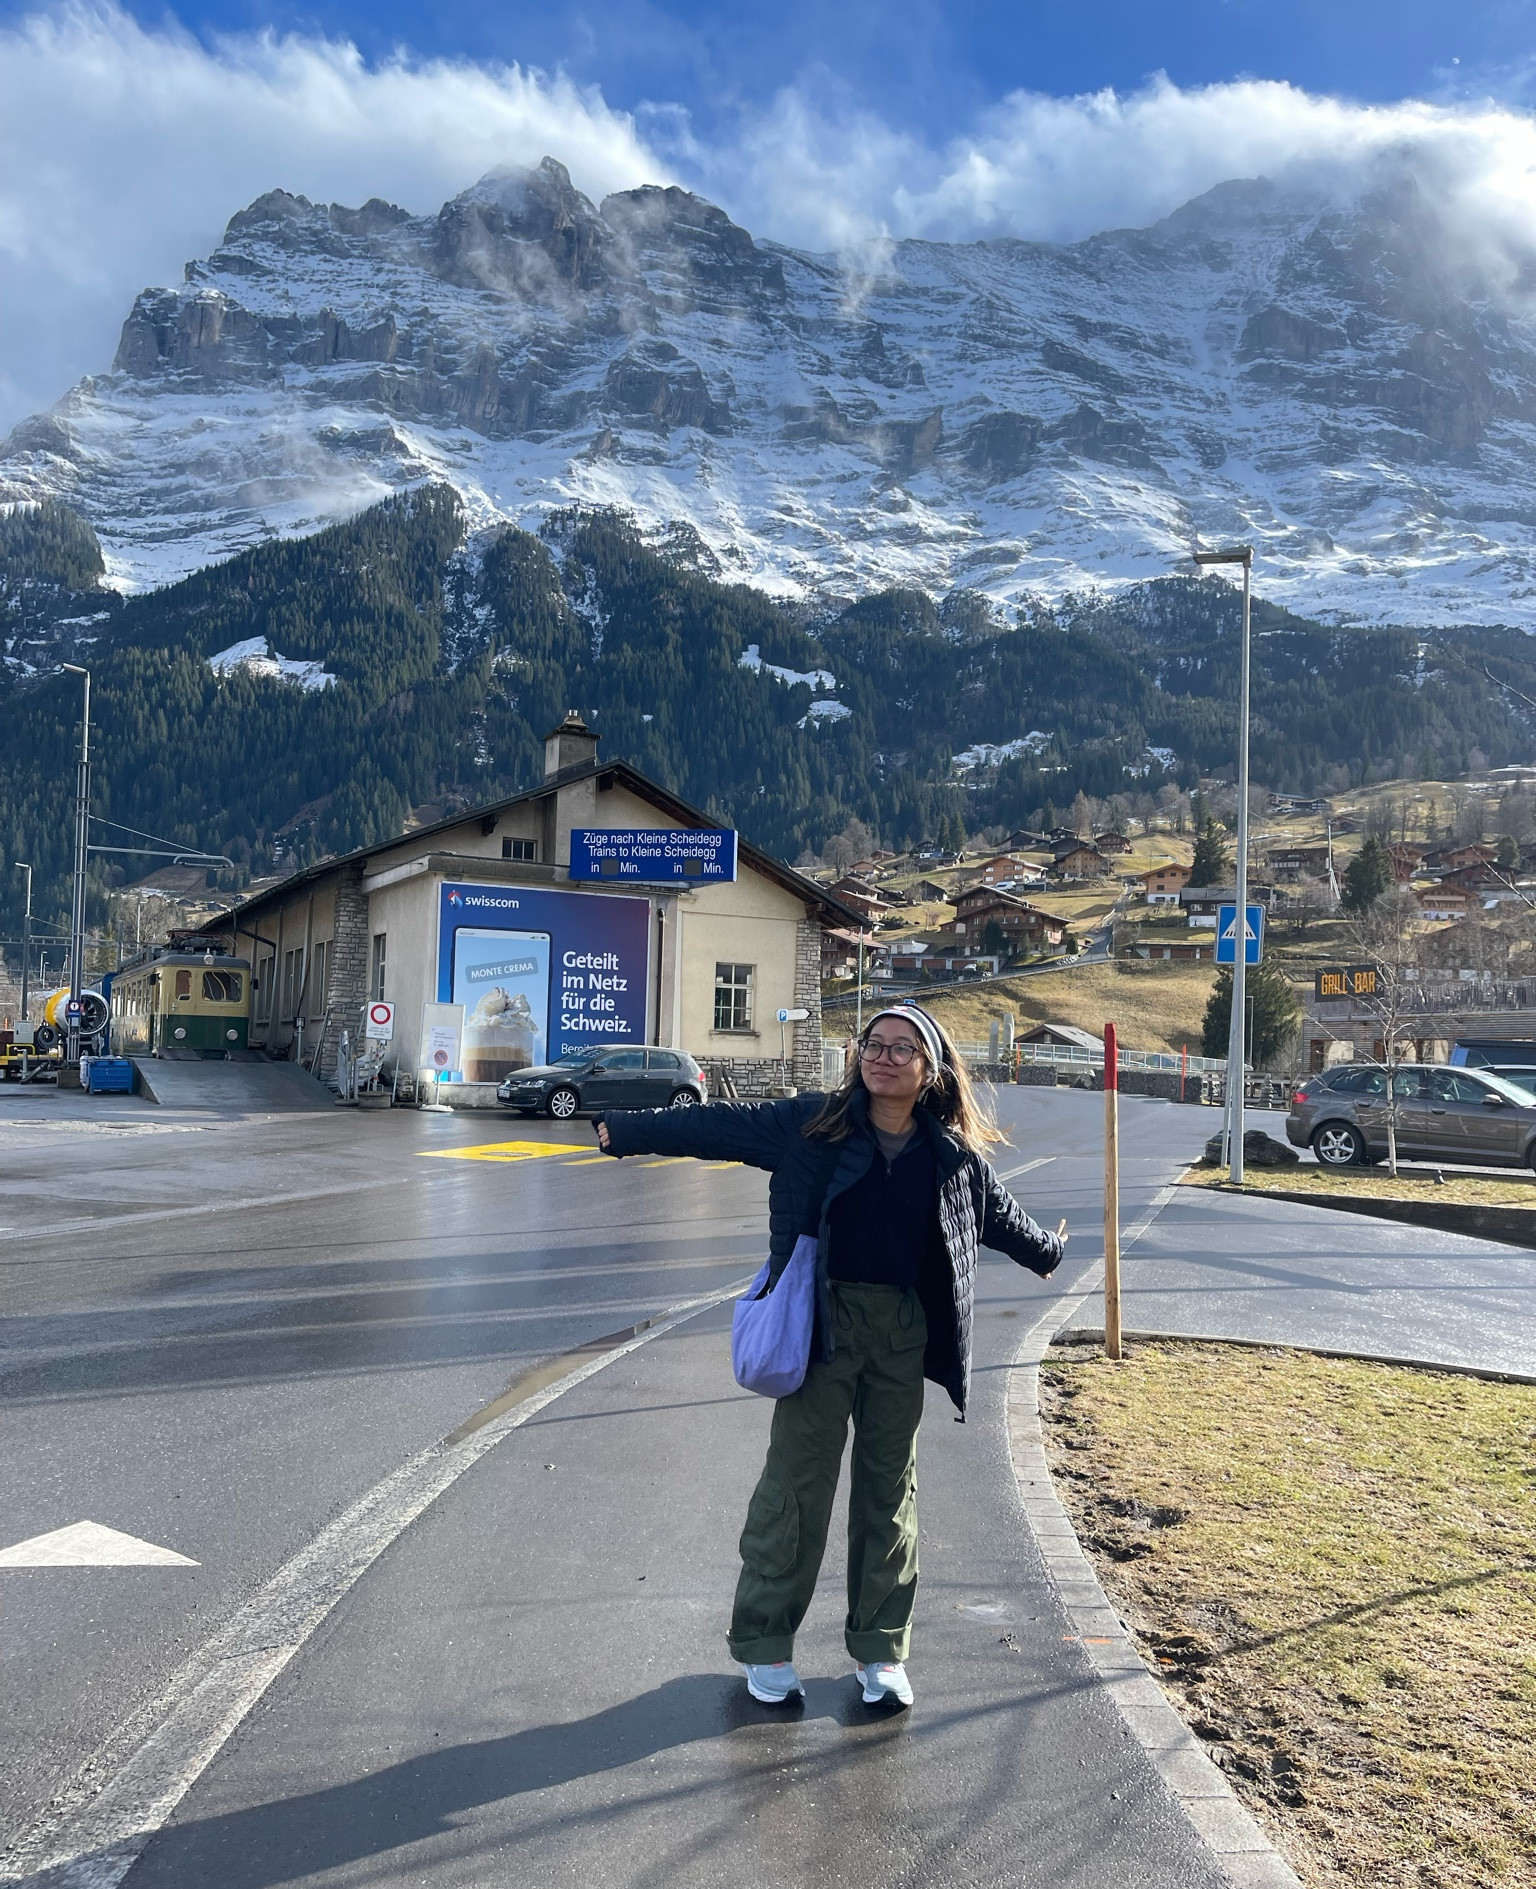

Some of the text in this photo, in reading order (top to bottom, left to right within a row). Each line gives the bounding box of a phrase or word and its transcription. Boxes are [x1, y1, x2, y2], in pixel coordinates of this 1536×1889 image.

[583, 832, 722, 846] Züge nach Kleine Scheidegg
[588, 845, 716, 860] Trains to Kleine Scheidegg
[590, 862, 641, 873] in Min.
[673, 862, 724, 874] in Min.
[465, 895, 519, 909] swisscom
[562, 951, 619, 970] Geteilt
[471, 962, 534, 979] MONTE CREMA
[562, 970, 628, 992] im Netz
[1321, 971, 1376, 995] GRILL BAR
[561, 991, 616, 1011] für die
[560, 1013, 632, 1033] Schweiz.
